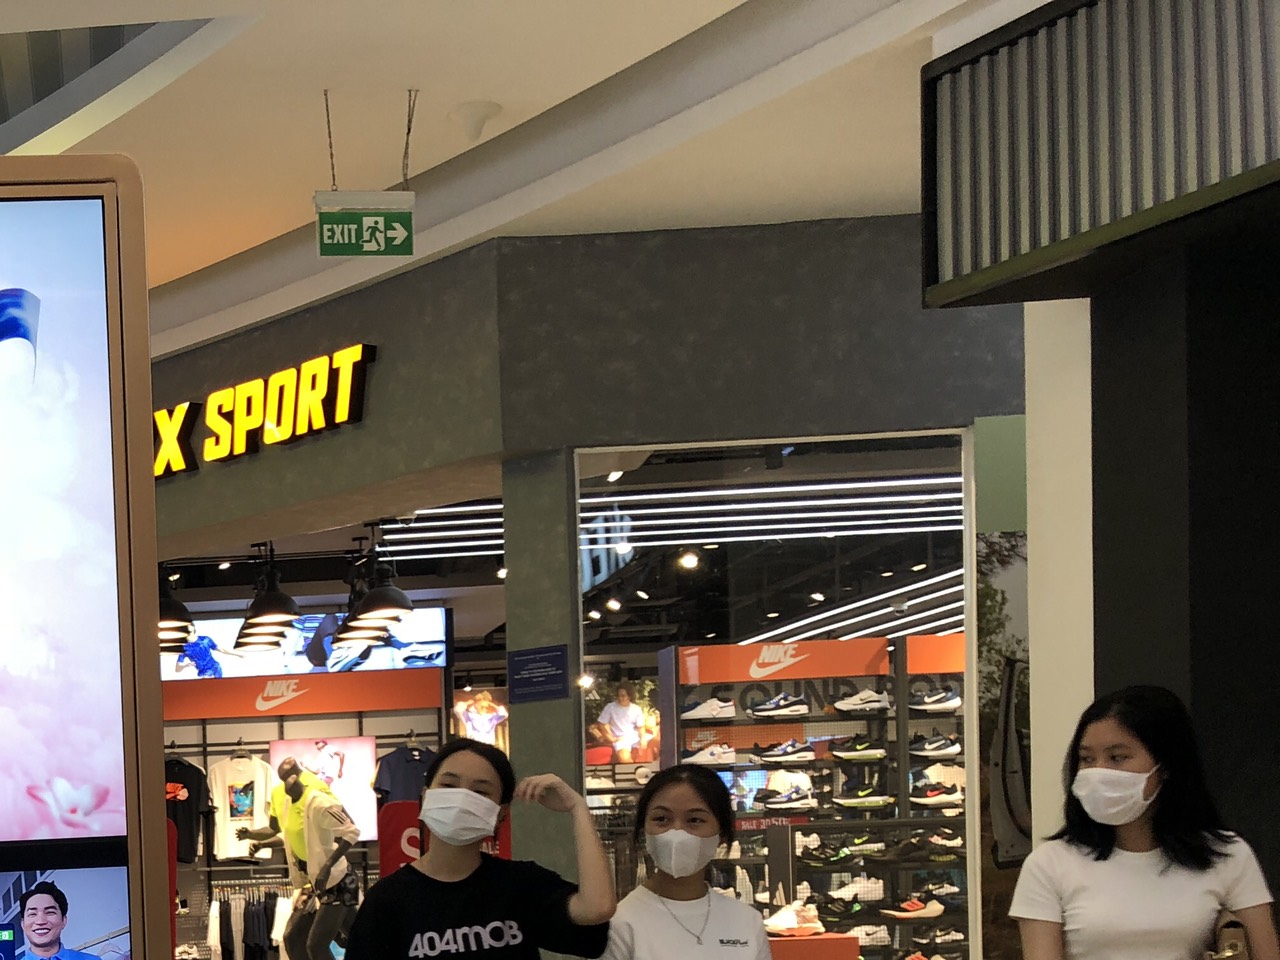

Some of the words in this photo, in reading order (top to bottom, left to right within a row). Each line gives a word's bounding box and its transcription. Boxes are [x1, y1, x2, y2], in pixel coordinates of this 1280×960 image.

[323, 224, 357, 244] EXIT
[203, 343, 363, 462] SPORT
[758, 643, 799, 663] NIKE
[263, 679, 300, 697] NIKE
